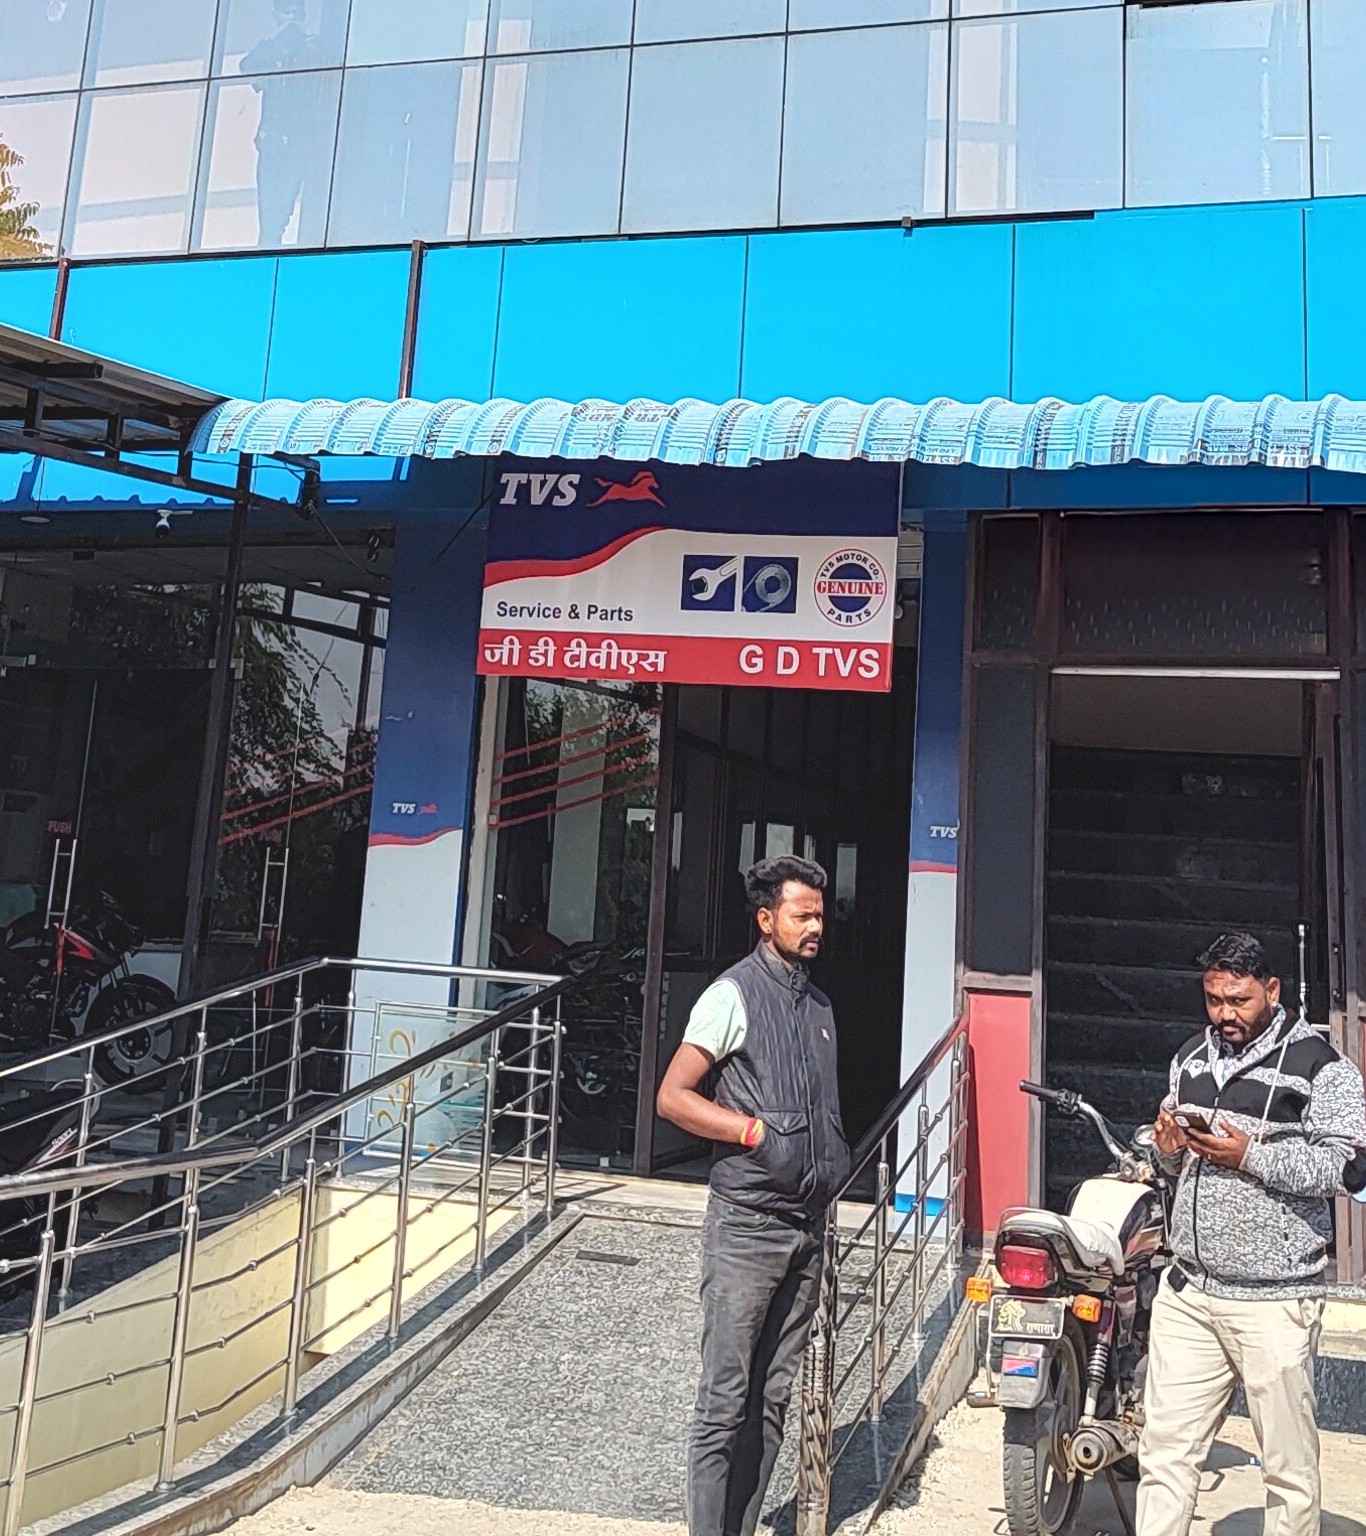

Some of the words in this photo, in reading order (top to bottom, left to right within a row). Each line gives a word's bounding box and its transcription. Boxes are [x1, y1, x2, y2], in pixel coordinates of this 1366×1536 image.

[499, 473, 580, 506] TVS
[835, 552, 869, 565] MOTOR
[816, 580, 884, 595] GENUINE
[496, 601, 562, 620] Service
[568, 604, 581, 620] &
[586, 604, 634, 622] Parts
[826, 607, 872, 624] PARTS
[484, 636, 520, 667] जी
[527, 637, 556, 668] डी
[563, 638, 667, 673] टीवीएस
[739, 644, 764, 674] G
[776, 645, 800, 675] D
[813, 646, 881, 679] TVS
[392, 802, 416, 814] TVS
[47, 820, 72, 835] PUSH
[929, 825, 958, 839] TVS
